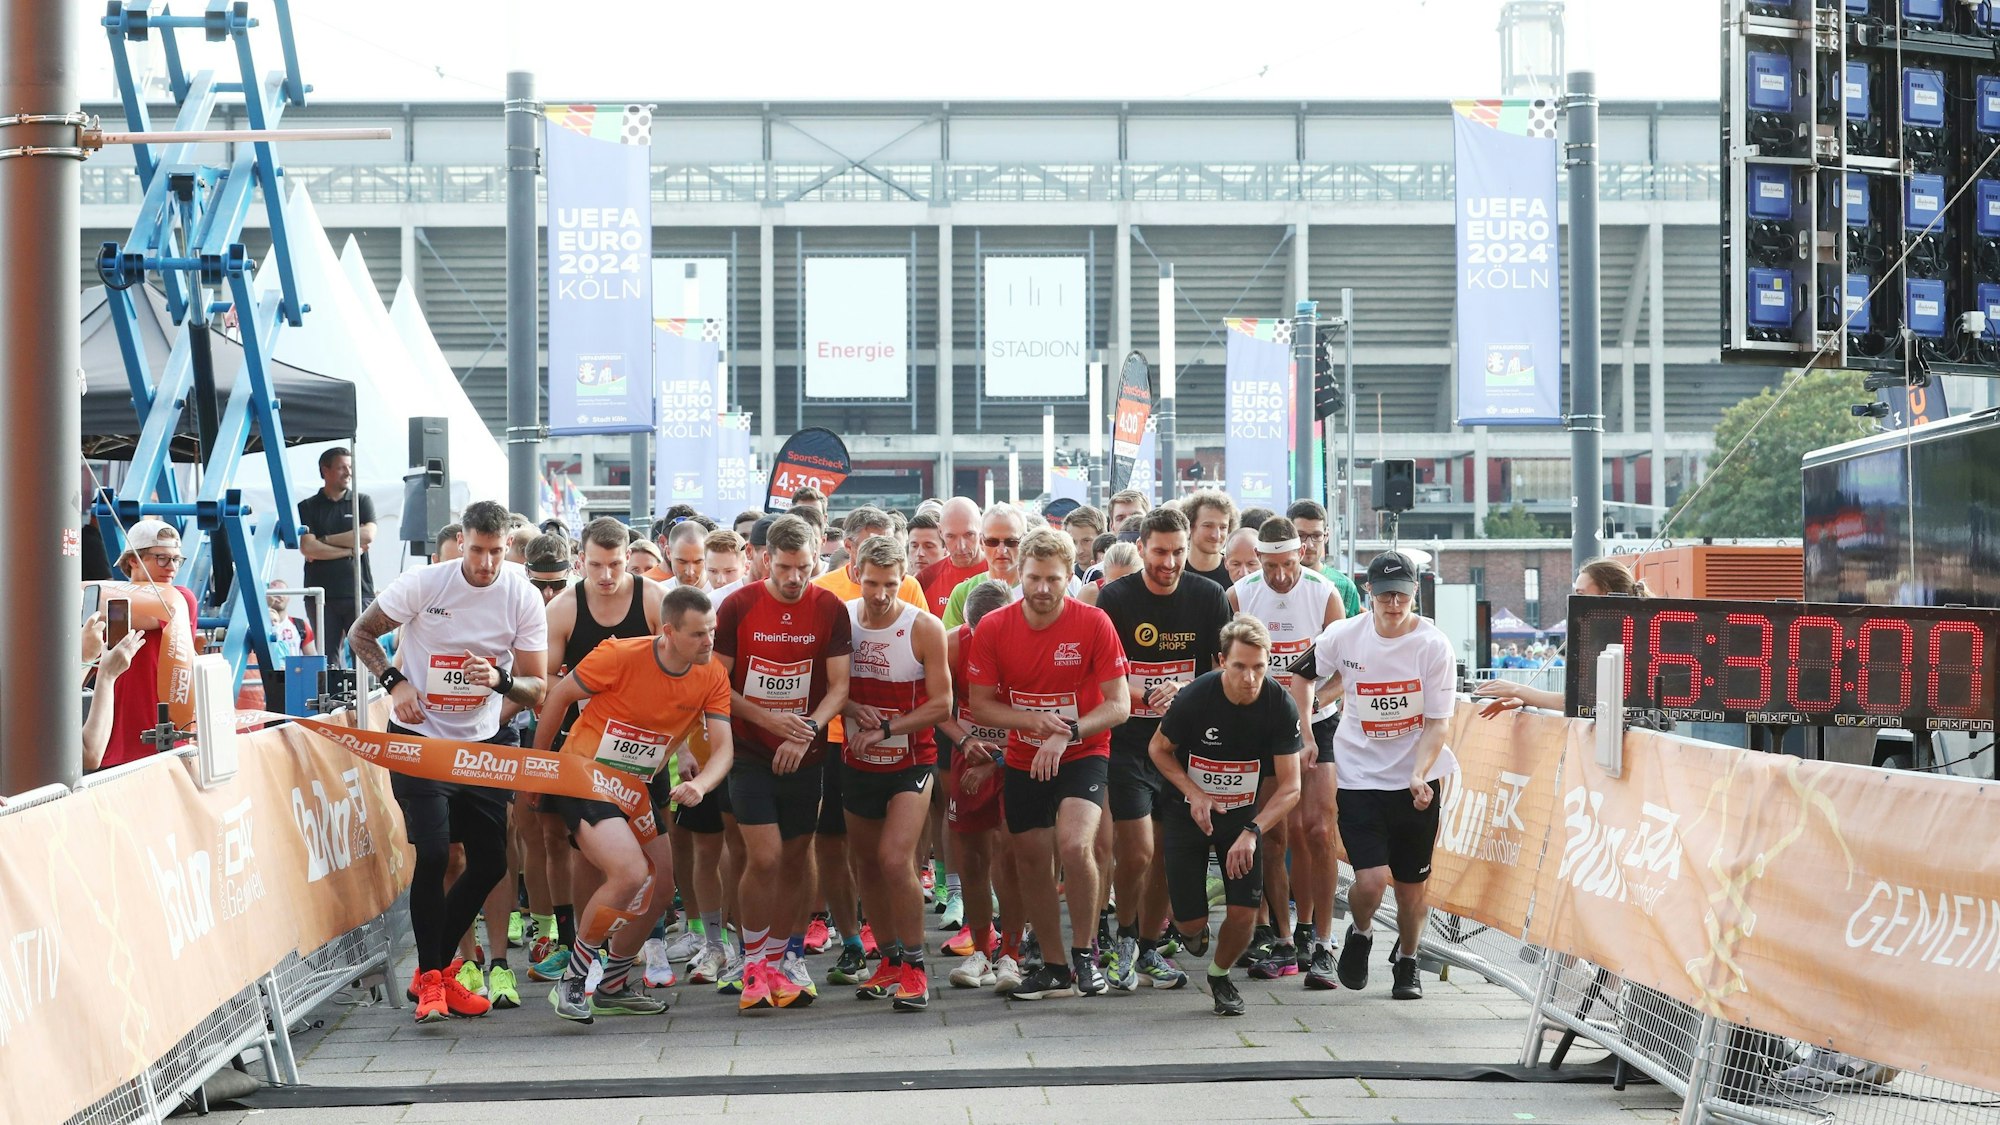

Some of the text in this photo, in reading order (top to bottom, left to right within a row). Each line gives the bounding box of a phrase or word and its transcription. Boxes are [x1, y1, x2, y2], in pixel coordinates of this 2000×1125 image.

[1466, 198, 1548, 218] UEFA
[557, 208, 641, 228] UEFA
[1466, 220, 1549, 240] EURO
[558, 230, 642, 251] EURO
[1467, 264, 1549, 289] KÖLN
[558, 274, 641, 300] KÖLN
[817, 341, 895, 361] Energie
[992, 340, 1079, 357] STADION
[661, 380, 712, 394] UEFA
[1231, 380, 1283, 395] UEFA
[661, 394, 713, 408] EURO
[1231, 395, 1283, 409] EURO
[592, 415, 627, 423] Stadt Köln
[662, 422, 712, 438] KÖLN
[1231, 422, 1282, 438] KÖLN
[718, 458, 746, 468] EFA
[787, 450, 844, 470] SportScheck
[718, 468, 746, 478] URO
[718, 478, 746, 488] 024
[718, 488, 746, 500] ÖLN
[1269, 622, 1279, 630] DB
[753, 631, 816, 645] RheinEnergie
[1159, 641, 1187, 651] SHOPS
[854, 664, 890, 677] GENERALI
[1054, 659, 1082, 667] GENERALI
[1621, 609, 1985, 717] 16:30:00
[176, 668, 191, 705] DAK
[758, 675, 801, 690] 16031
[1370, 696, 1409, 711] 4654
[971, 725, 1006, 739] 2666
[386, 741, 423, 757] DAK
[613, 739, 657, 758] 18074
[385, 752, 421, 764] Gesundheit
[453, 749, 519, 774] B2Run
[525, 756, 560, 773] DAK
[451, 767, 516, 782] GEMEINSAM.AKTIV
[524, 768, 559, 780] Gesundheit
[1203, 773, 1243, 786] 9532
[593, 769, 642, 806] B2Run
[1437, 768, 1488, 858] Run
[1845, 880, 2000, 972] GEMEIN
